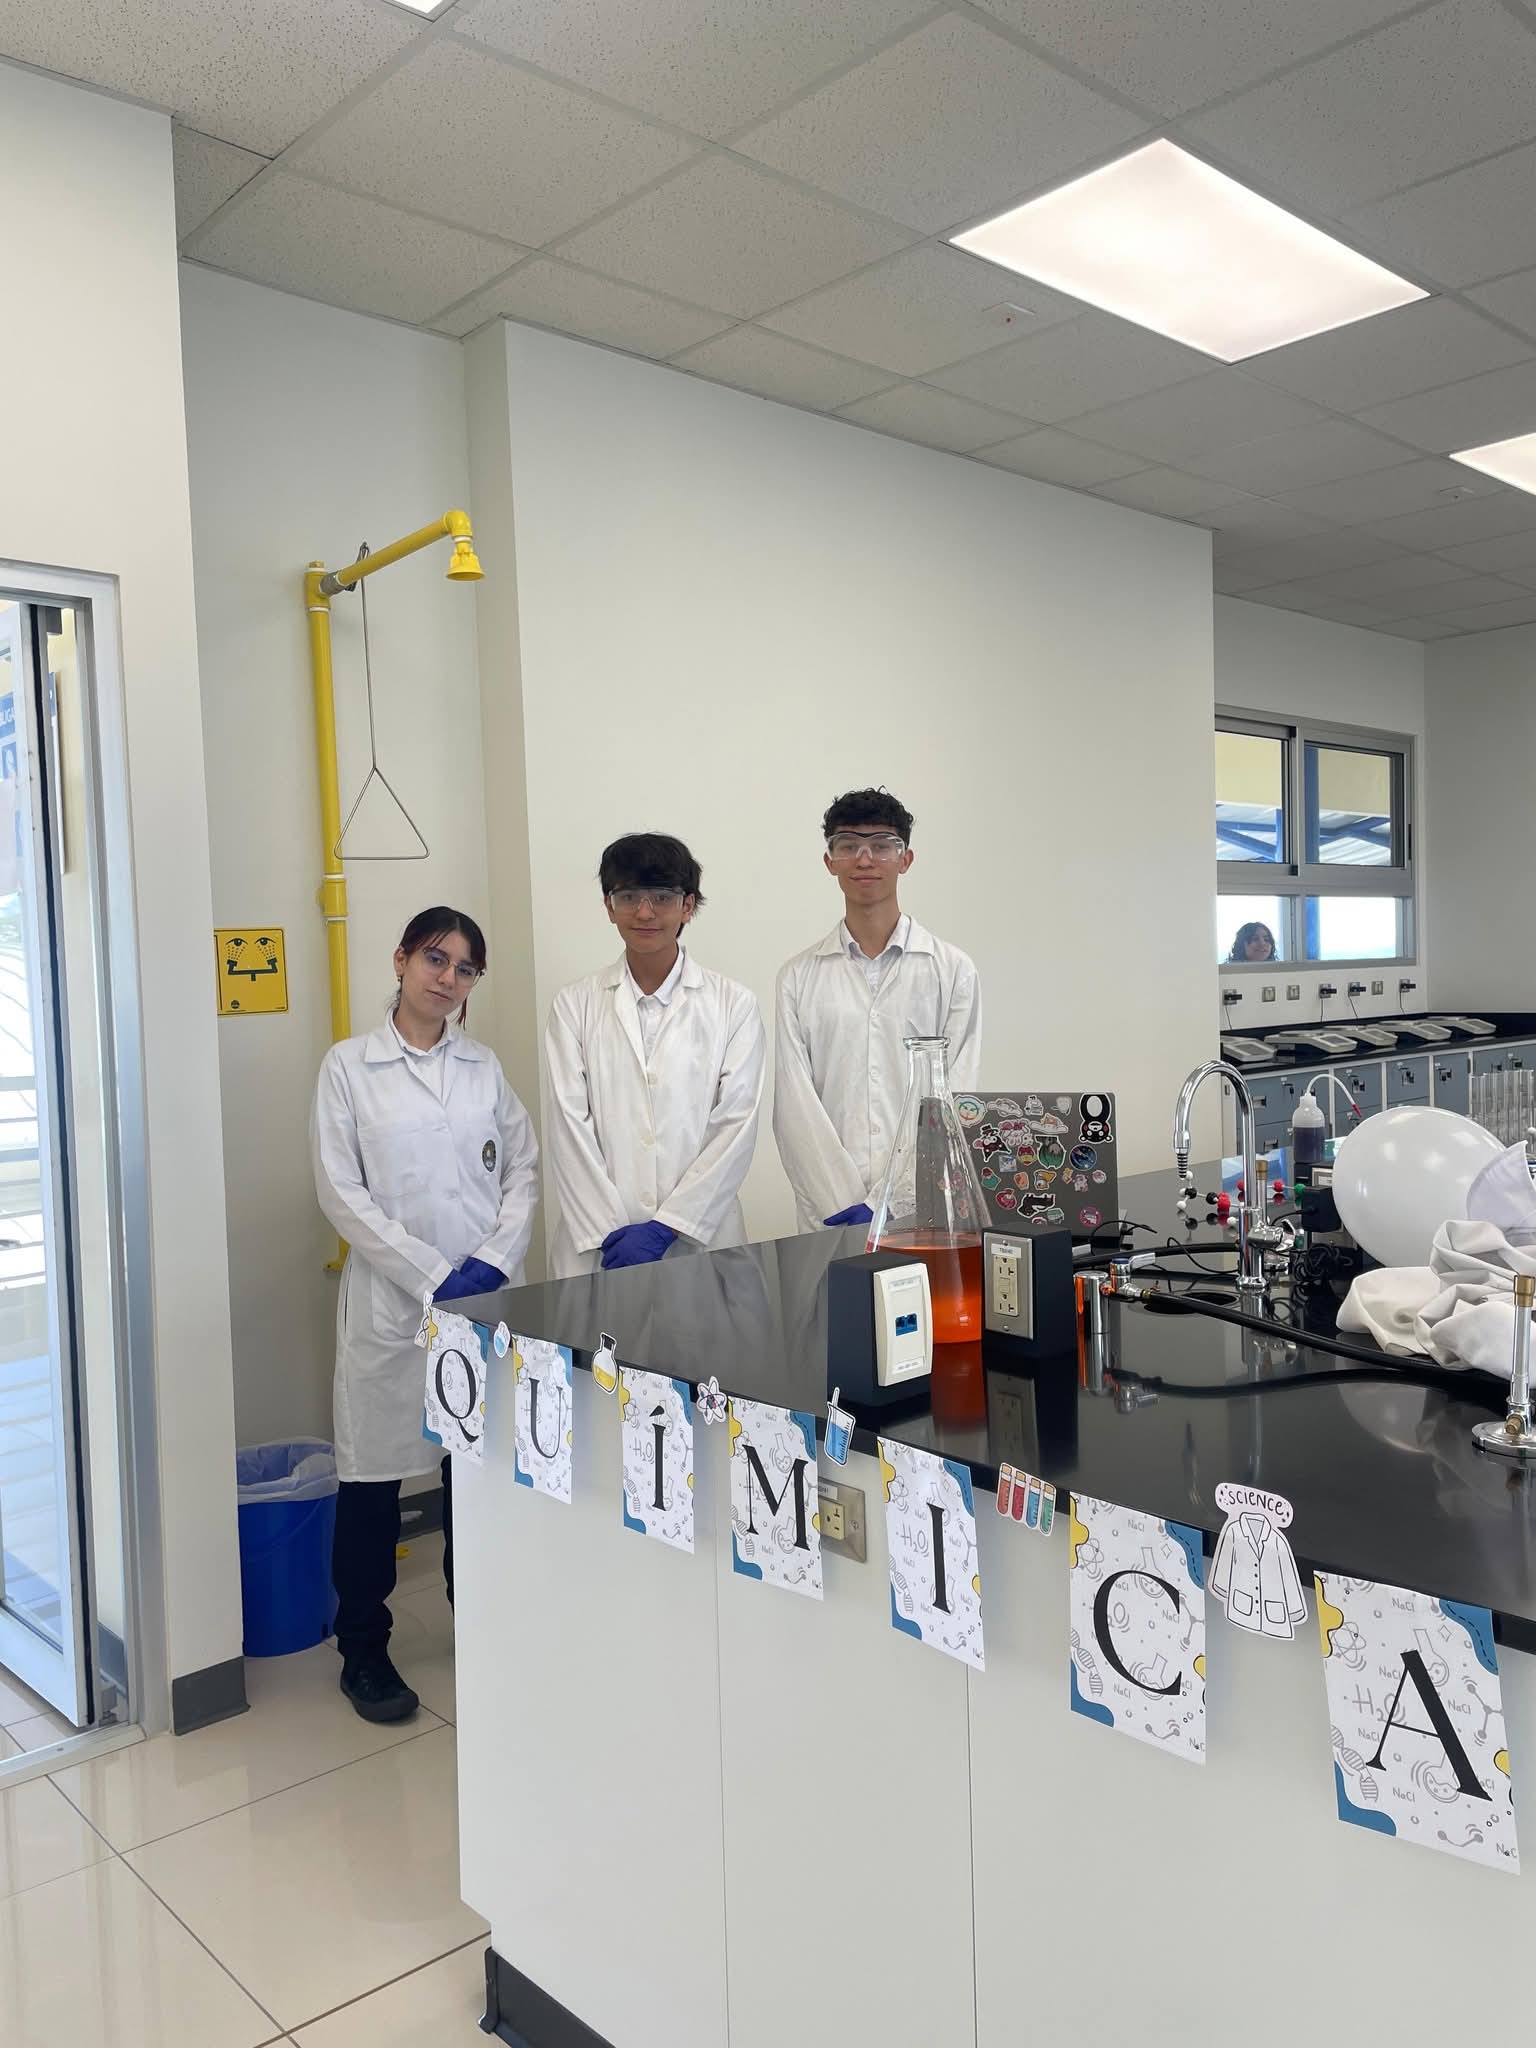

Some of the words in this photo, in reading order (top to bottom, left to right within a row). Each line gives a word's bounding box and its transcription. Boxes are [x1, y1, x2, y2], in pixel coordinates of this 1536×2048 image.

[1391, 1597, 1415, 1613] NaCl
[1378, 1664, 1401, 1681] NaCl
[1448, 1700, 1471, 1715] NaCl
[1357, 1727, 1380, 1742] NaCl
[1392, 1787, 1416, 1803] NaCl
